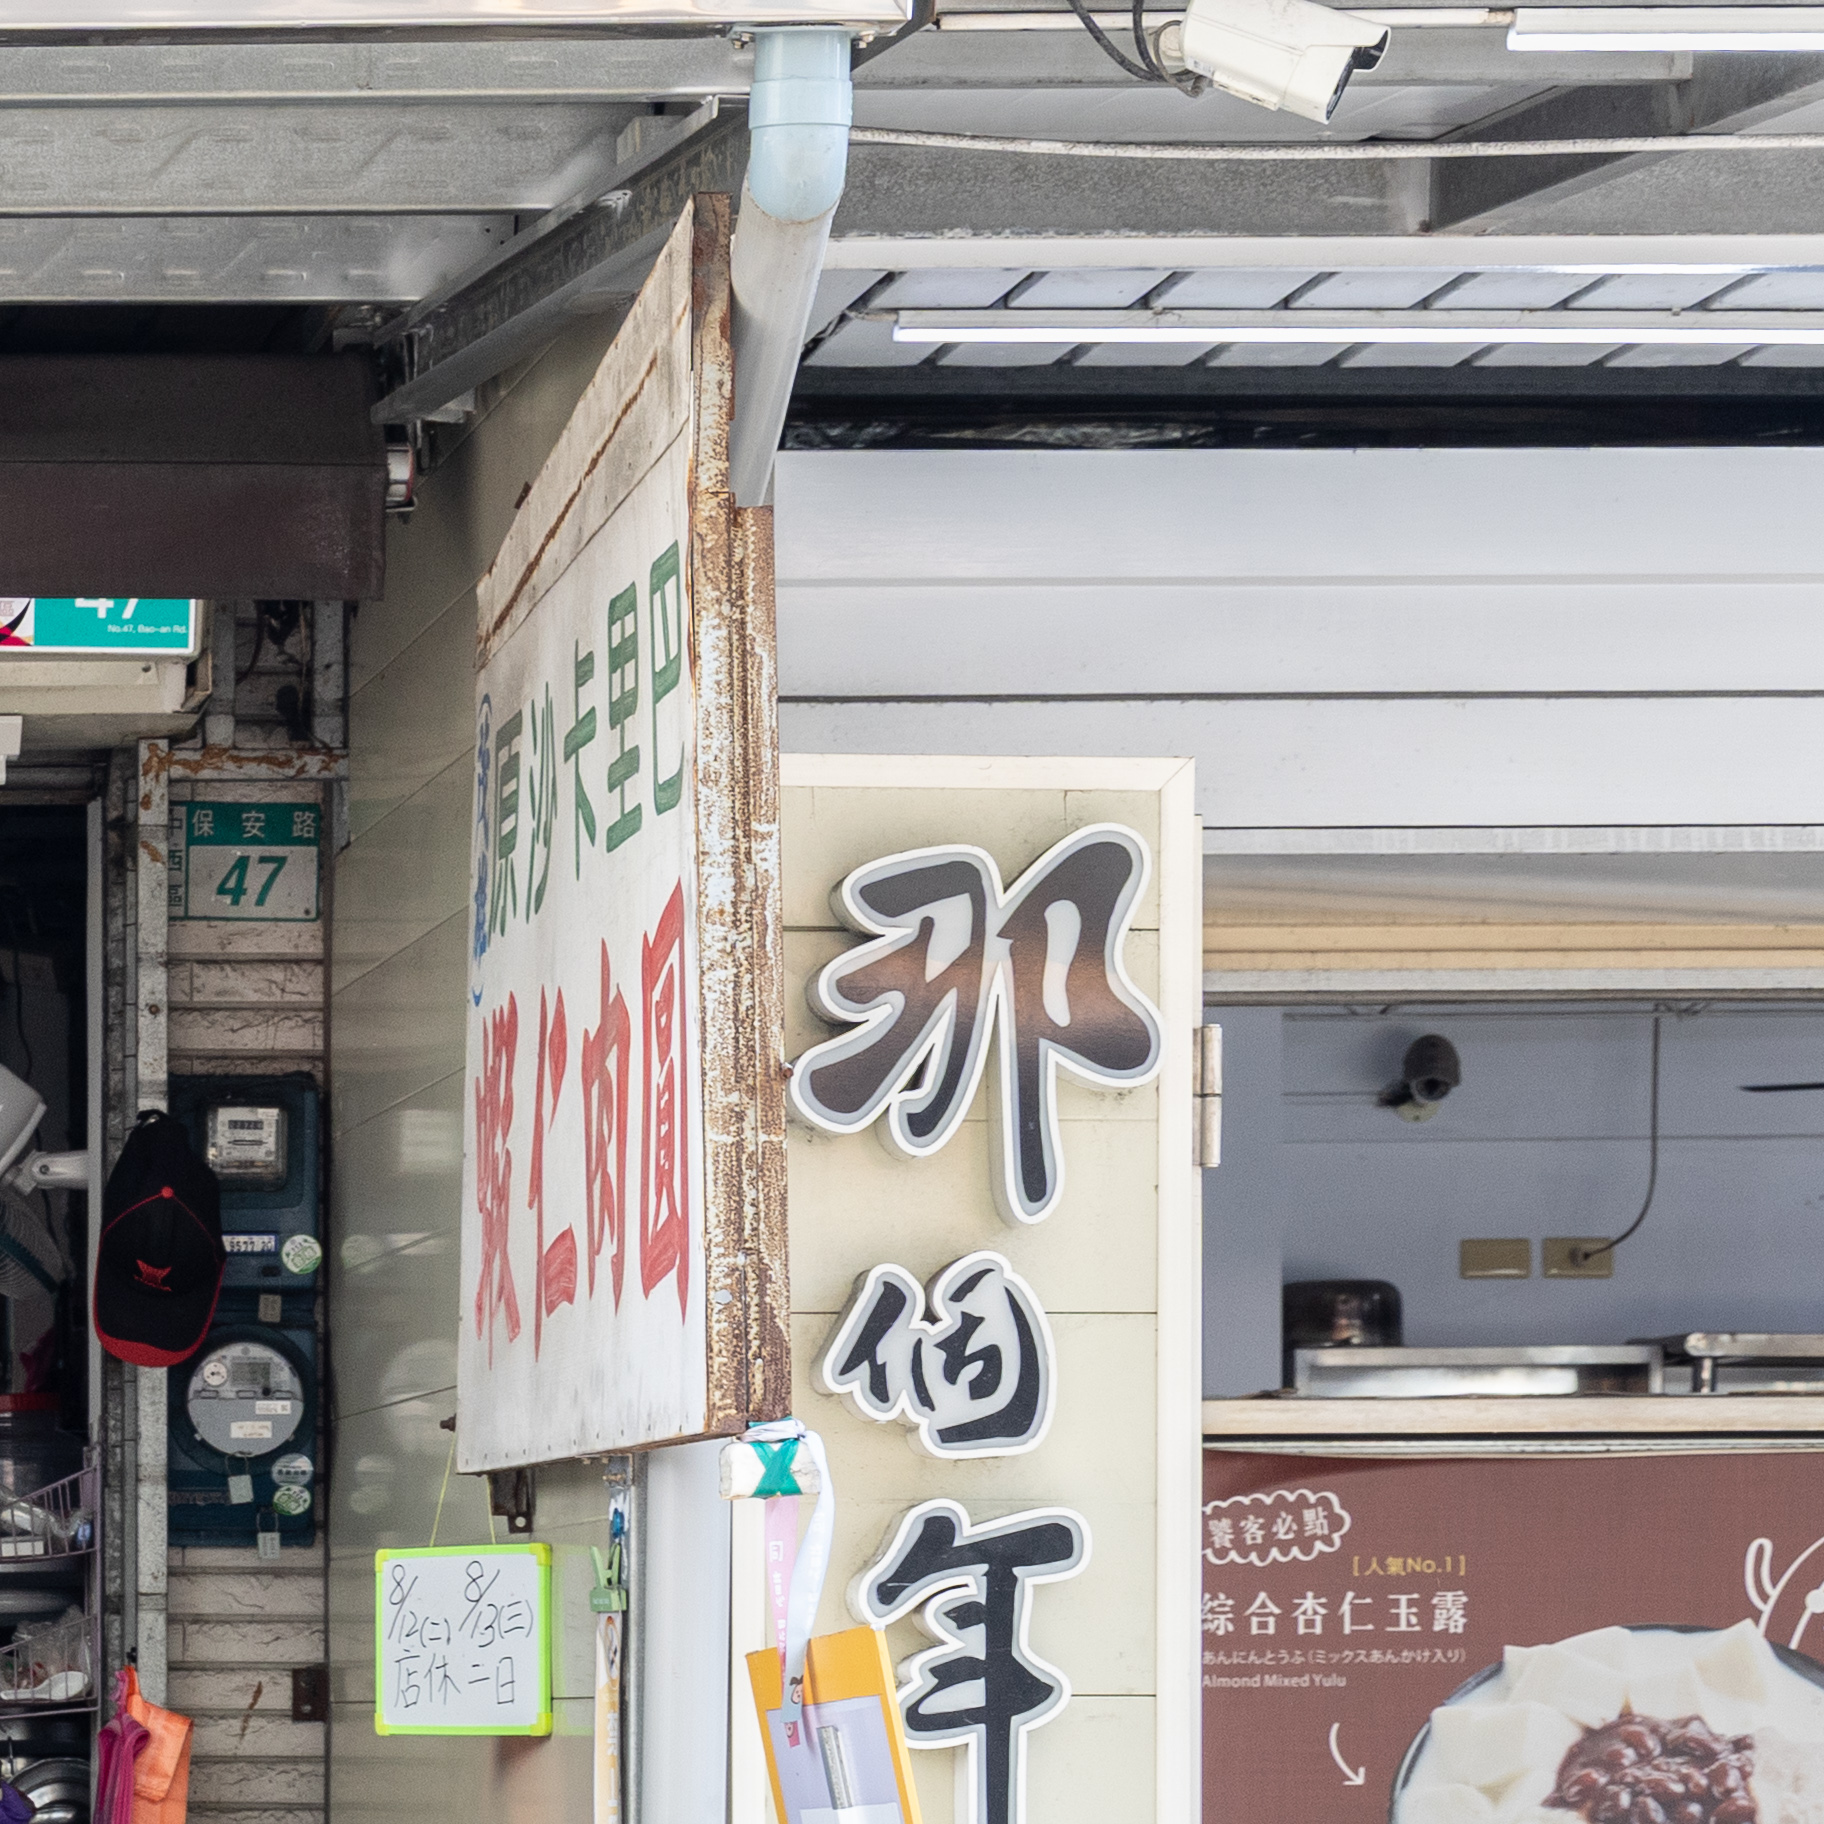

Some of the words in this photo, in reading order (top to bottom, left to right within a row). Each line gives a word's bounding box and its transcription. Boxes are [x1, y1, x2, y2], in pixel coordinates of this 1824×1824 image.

[138, 624, 171, 634] Bao-an
[173, 624, 188, 634] Rd.
[488, 536, 686, 947] 原沙卡里巴
[192, 809, 316, 839] 保安路
[216, 855, 289, 907] 47
[472, 874, 691, 1371] 蝦仁肉圓
[1208, 1506, 1331, 1549] 饕客必點
[393, 1650, 517, 1709] 店休二日
[1202, 1674, 1261, 1688] Almond
[1263, 1674, 1311, 1688] Mixed
[1313, 1674, 1348, 1688] Yulu
